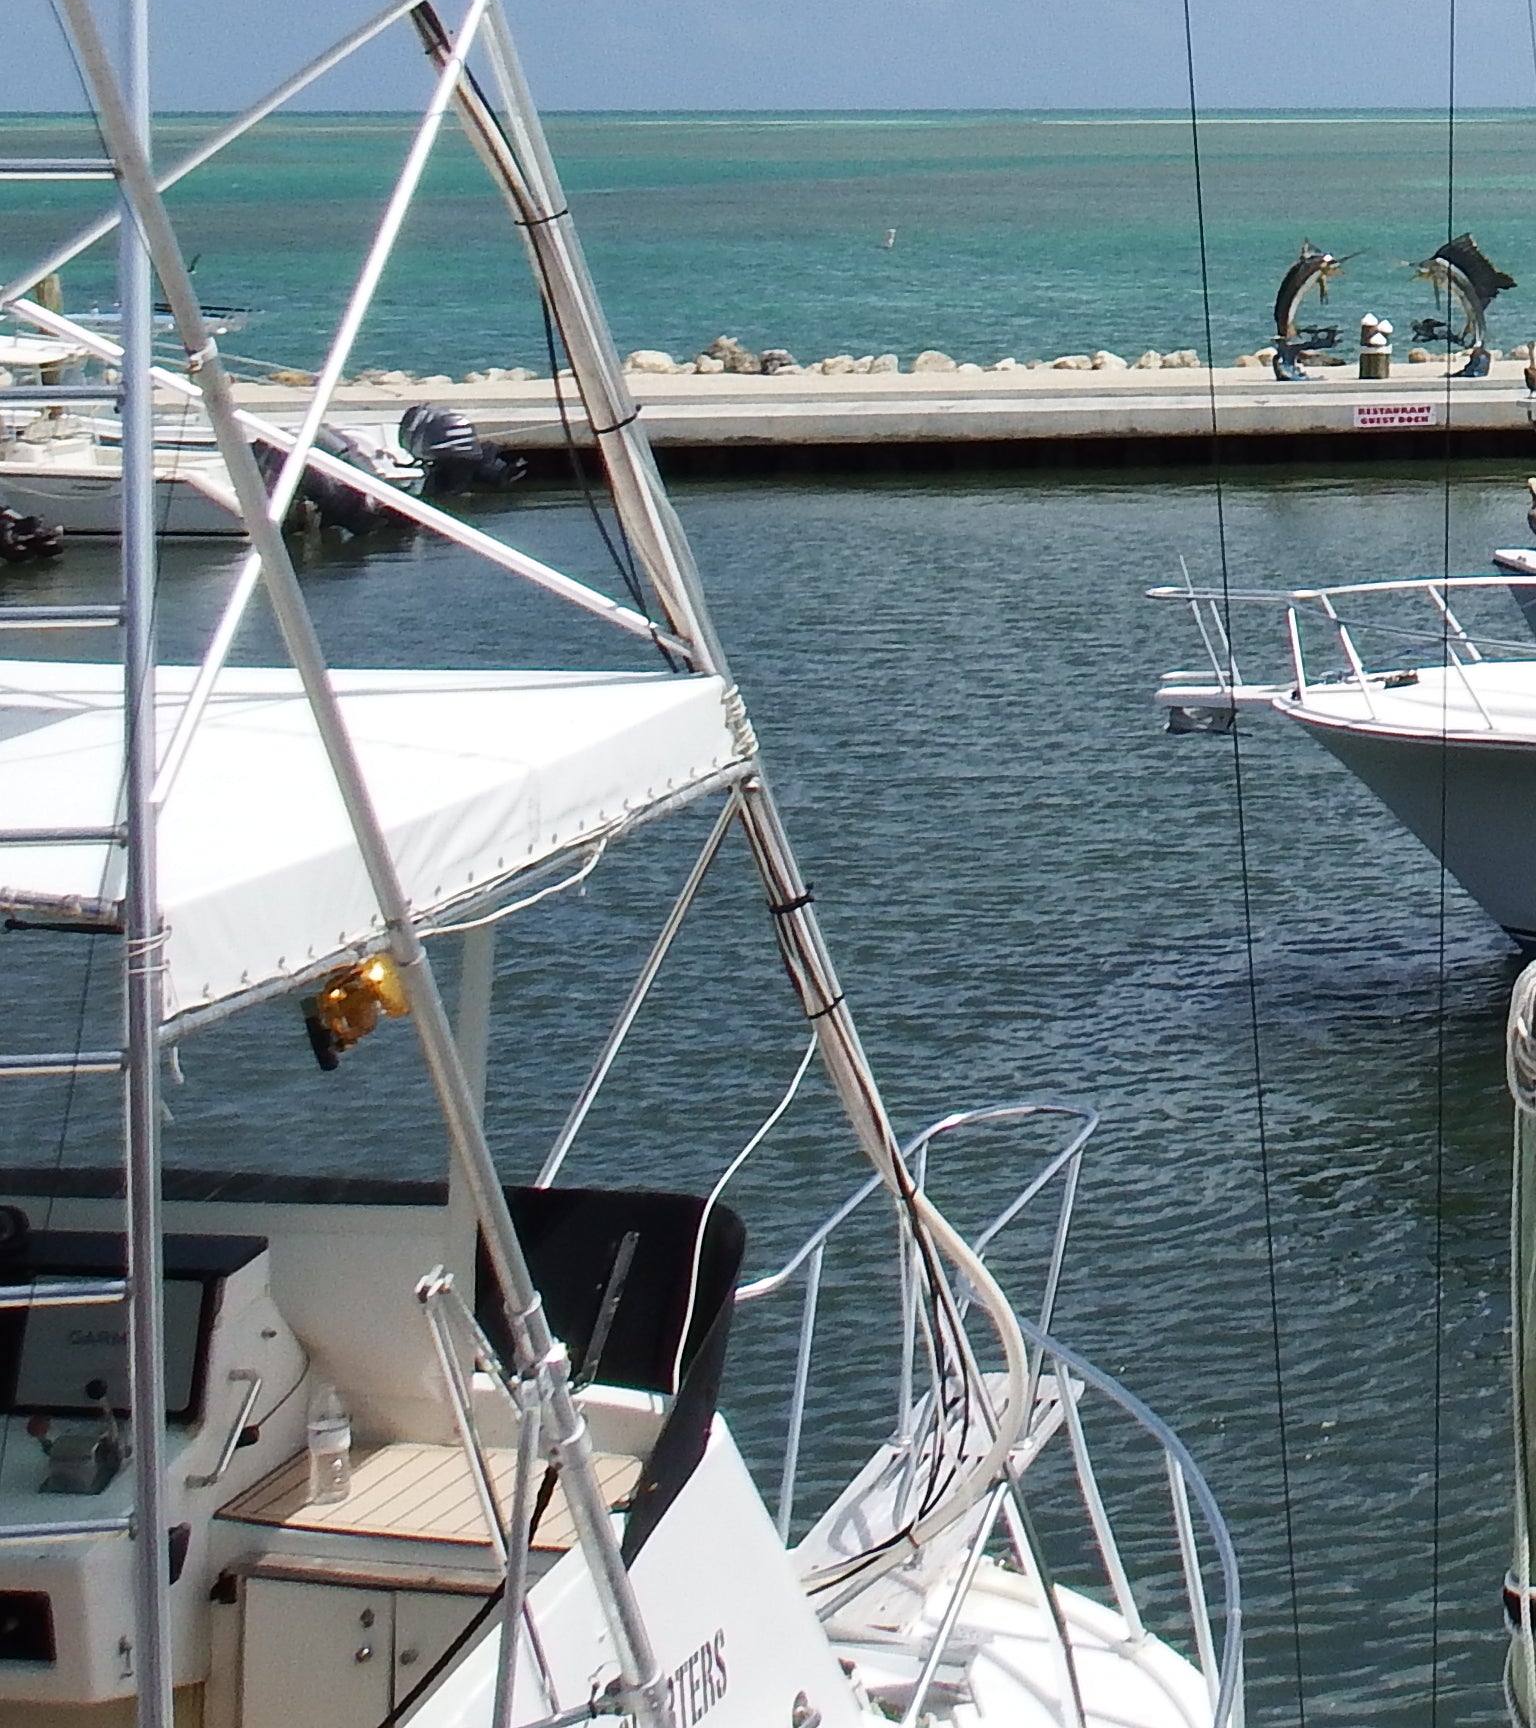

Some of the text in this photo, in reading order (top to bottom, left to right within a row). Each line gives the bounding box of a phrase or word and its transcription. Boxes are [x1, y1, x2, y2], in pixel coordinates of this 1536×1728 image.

[1358, 406, 1431, 415] RESTAURANT
[1360, 416, 1395, 424] GUEST
[69, 1329, 128, 1345] GARM
